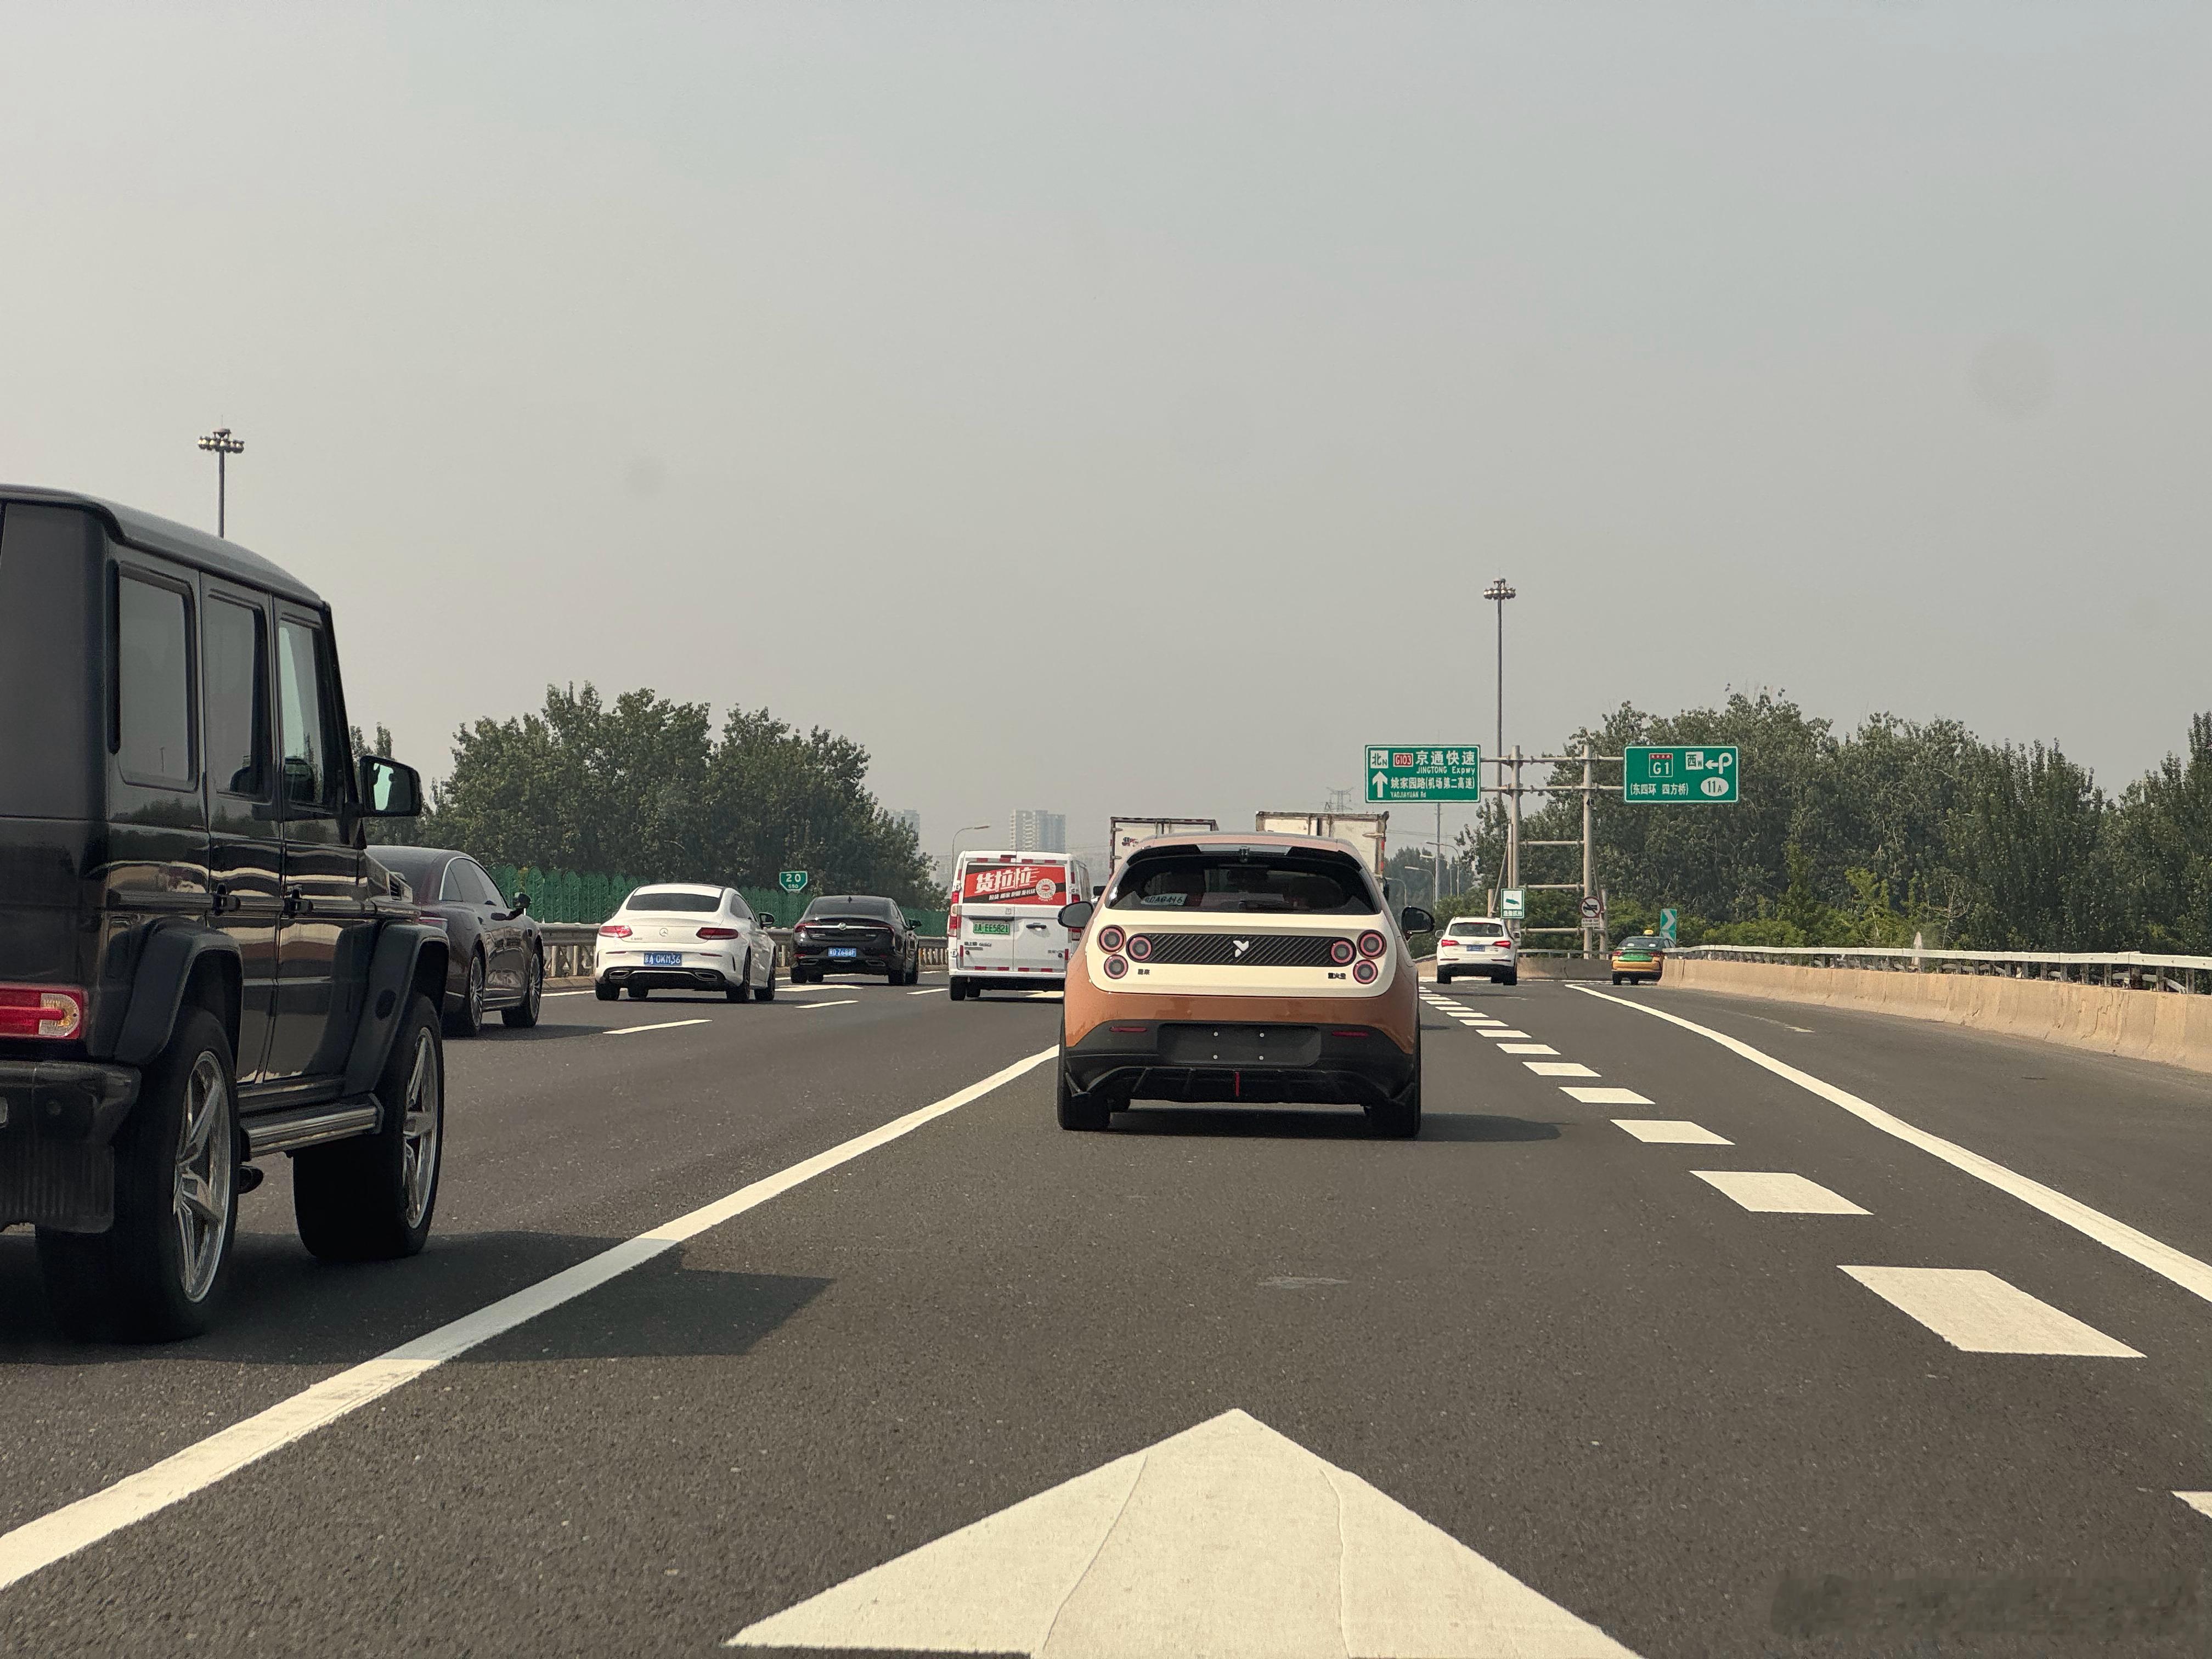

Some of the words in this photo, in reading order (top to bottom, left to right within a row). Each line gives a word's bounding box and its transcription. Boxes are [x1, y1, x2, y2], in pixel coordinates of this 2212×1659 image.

[1395, 755, 1412, 765] G103
[1415, 750, 1476, 766] 京通快速
[1452, 766, 1476, 775] Expwy
[1653, 762, 1669, 775] G1
[1707, 781, 1723, 793] 11A
[786, 873, 801, 883] 20
[974, 866, 1034, 894] 货拉拉
